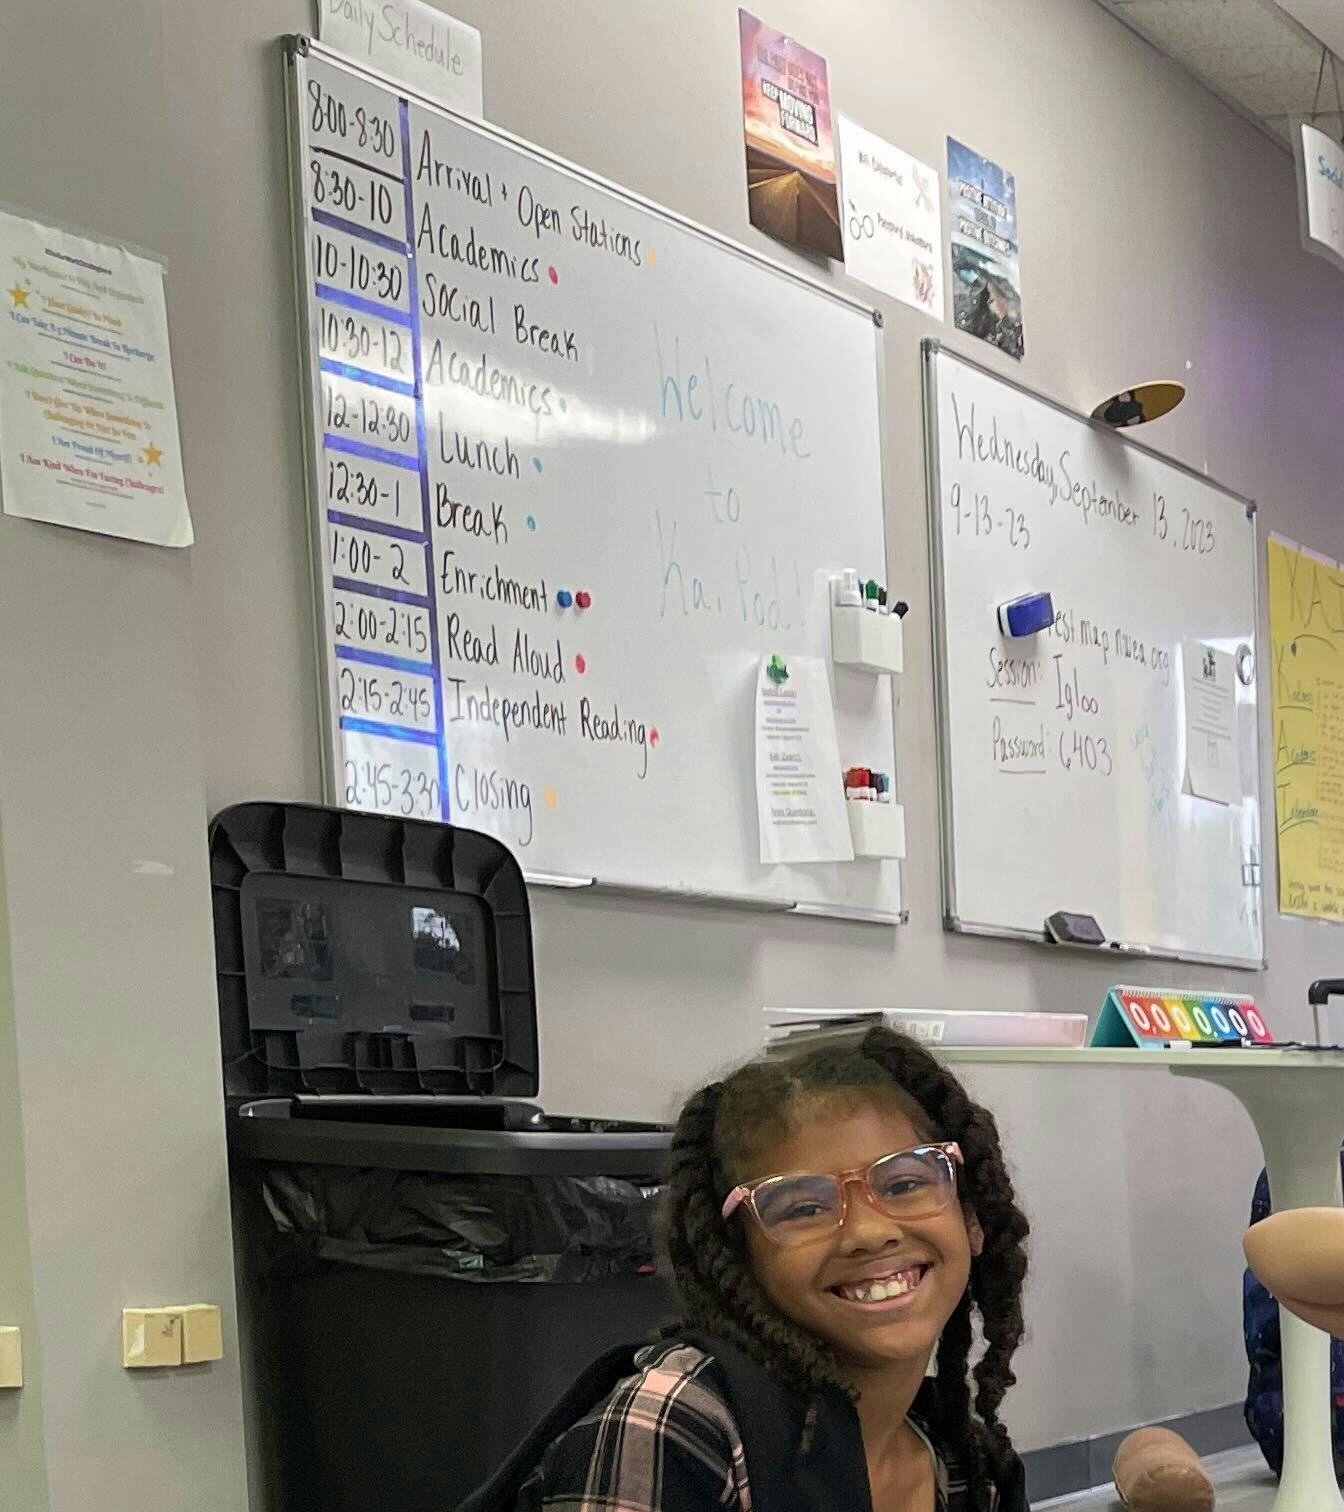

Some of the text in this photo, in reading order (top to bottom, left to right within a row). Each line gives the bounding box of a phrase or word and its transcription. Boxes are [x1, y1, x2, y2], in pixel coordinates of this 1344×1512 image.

[378, 5, 465, 76] Schedule
[310, 160, 394, 225] 8:30-10
[416, 129, 494, 208] Arrival
[517, 185, 562, 239] Open
[571, 205, 643, 268] Stations
[315, 233, 403, 302] 10-10:30
[417, 203, 541, 284] Academics
[319, 308, 403, 372] 10:30-12
[422, 272, 579, 363] Social Break
[425, 339, 555, 418] Academics
[325, 393, 412, 445] 12-12:30
[438, 425, 521, 478] Lunch
[327, 460, 401, 519] 12:30-1
[434, 481, 510, 544] Break
[703, 461, 741, 525] to
[950, 483, 1032, 550] 9-13-23
[1059, 450, 1140, 525] September
[1181, 507, 1216, 555] 2023
[440, 551, 550, 612] Enrichment
[334, 600, 430, 654] 2:00-2:15
[446, 612, 566, 684] Read Aloud
[339, 668, 432, 719] 2:15-2:45
[986, 646, 1099, 721] Session: Igloo
[446, 676, 649, 779] Independent Reading
[1058, 729, 1113, 778] 6403
[455, 763, 533, 848] Closing
